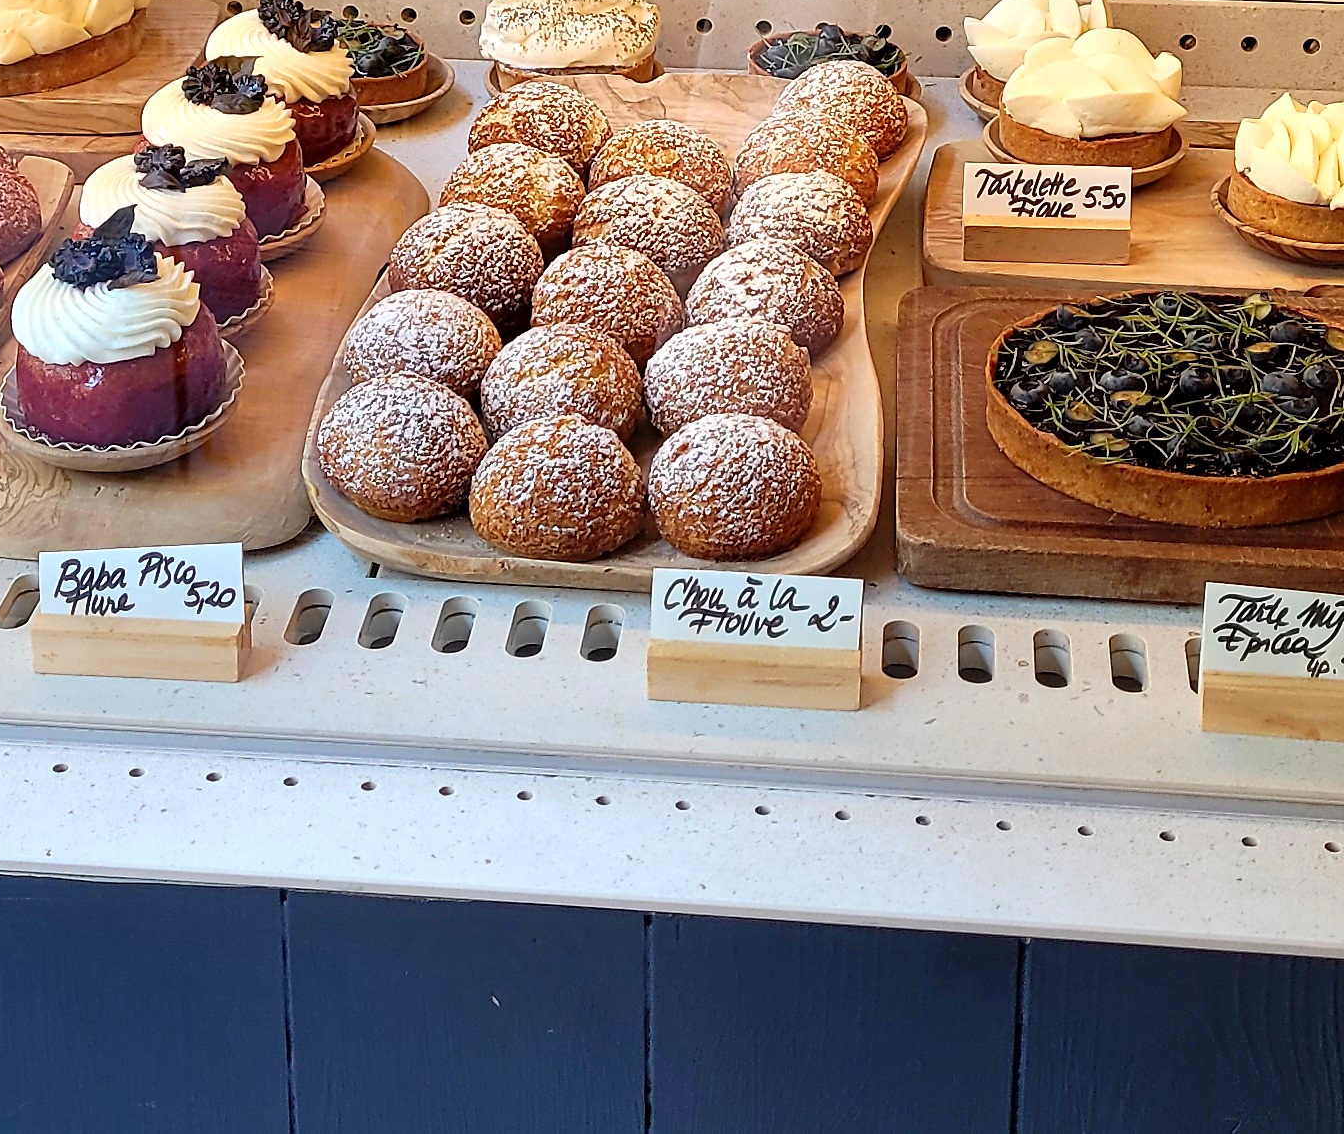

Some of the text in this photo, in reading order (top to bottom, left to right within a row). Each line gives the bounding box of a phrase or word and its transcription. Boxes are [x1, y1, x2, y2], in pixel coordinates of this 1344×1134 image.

[974, 168, 1081, 198] Tartelette
[53, 551, 197, 599] Baba Pisco
[663, 575, 727, 610] Chou
[737, 575, 764, 609] à
[769, 578, 811, 612] la
[183, 580, 237, 615] 5,20
[1218, 593, 1292, 632] Tarte
